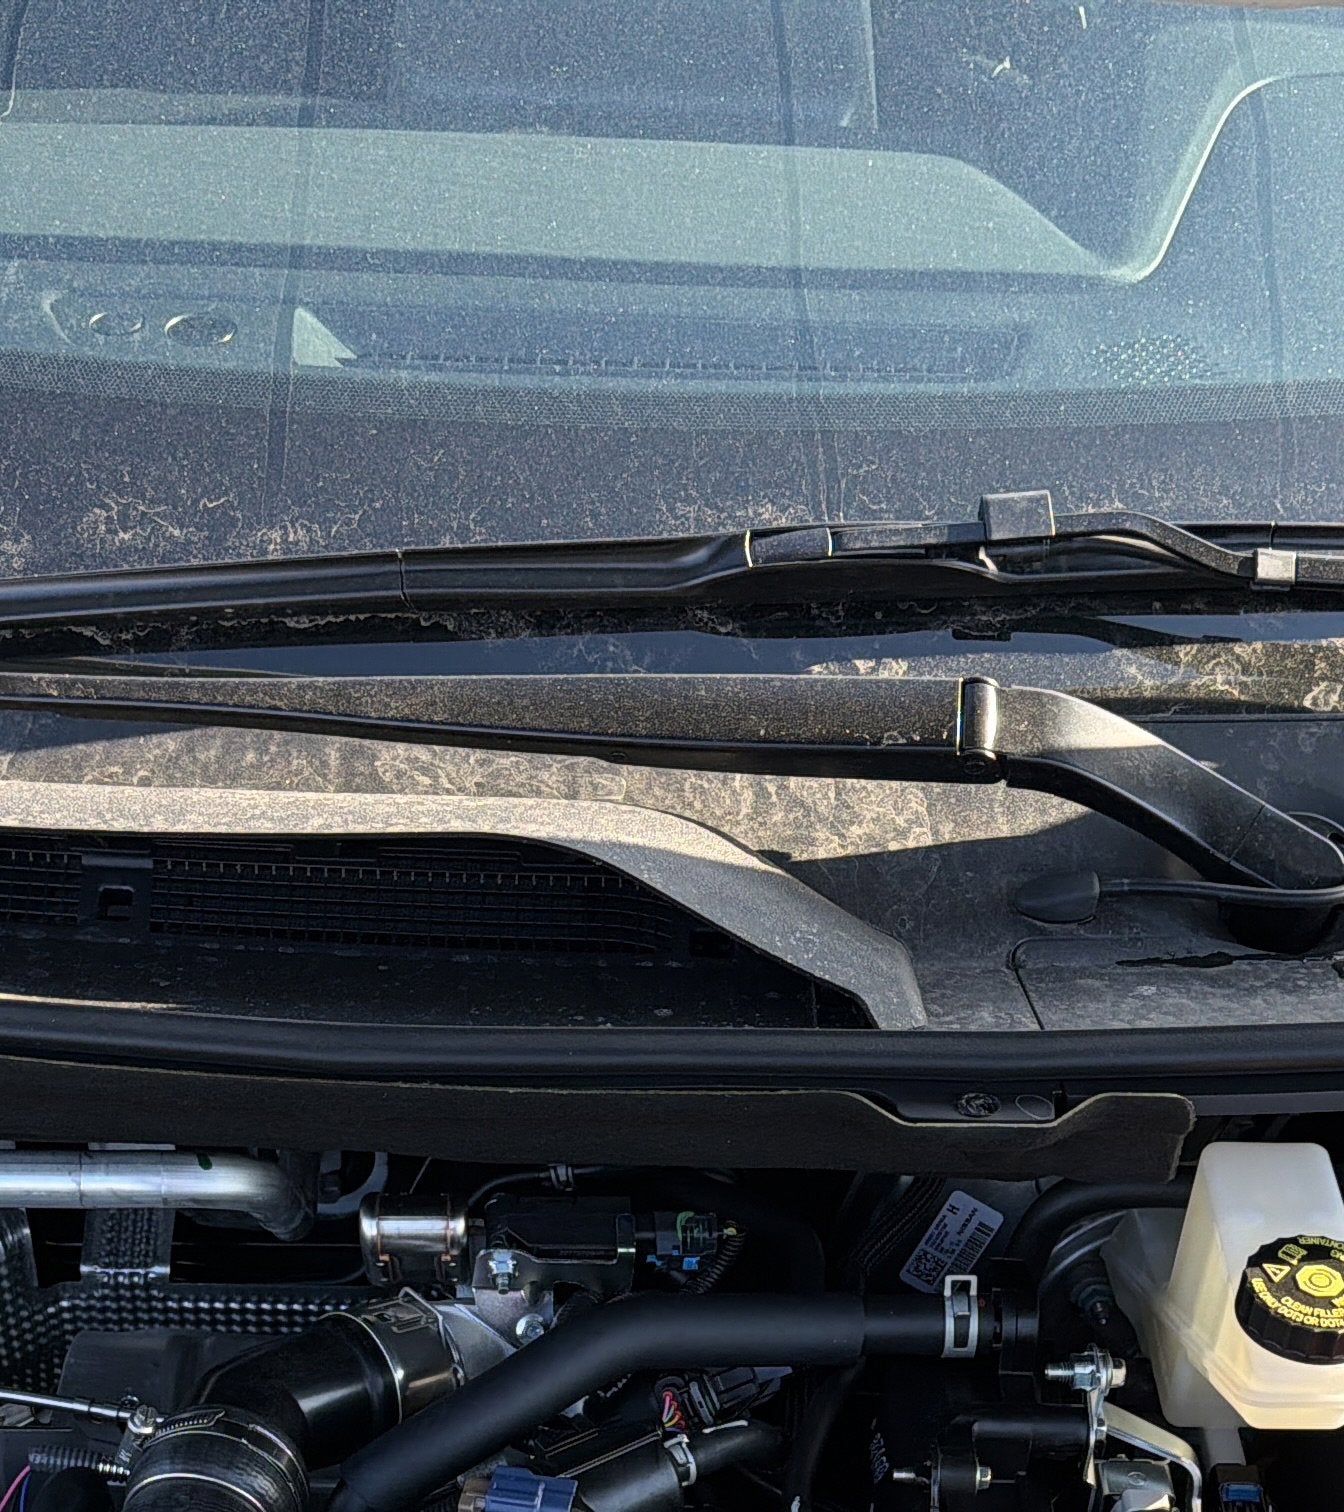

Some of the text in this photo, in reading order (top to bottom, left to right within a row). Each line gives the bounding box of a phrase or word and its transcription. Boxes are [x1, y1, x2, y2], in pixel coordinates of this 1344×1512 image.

[946, 1204, 960, 1215] H
[1281, 1296, 1313, 1315] CLEAN
[1277, 1306, 1304, 1322] DOT3
[1304, 1315, 1319, 1327] OR
